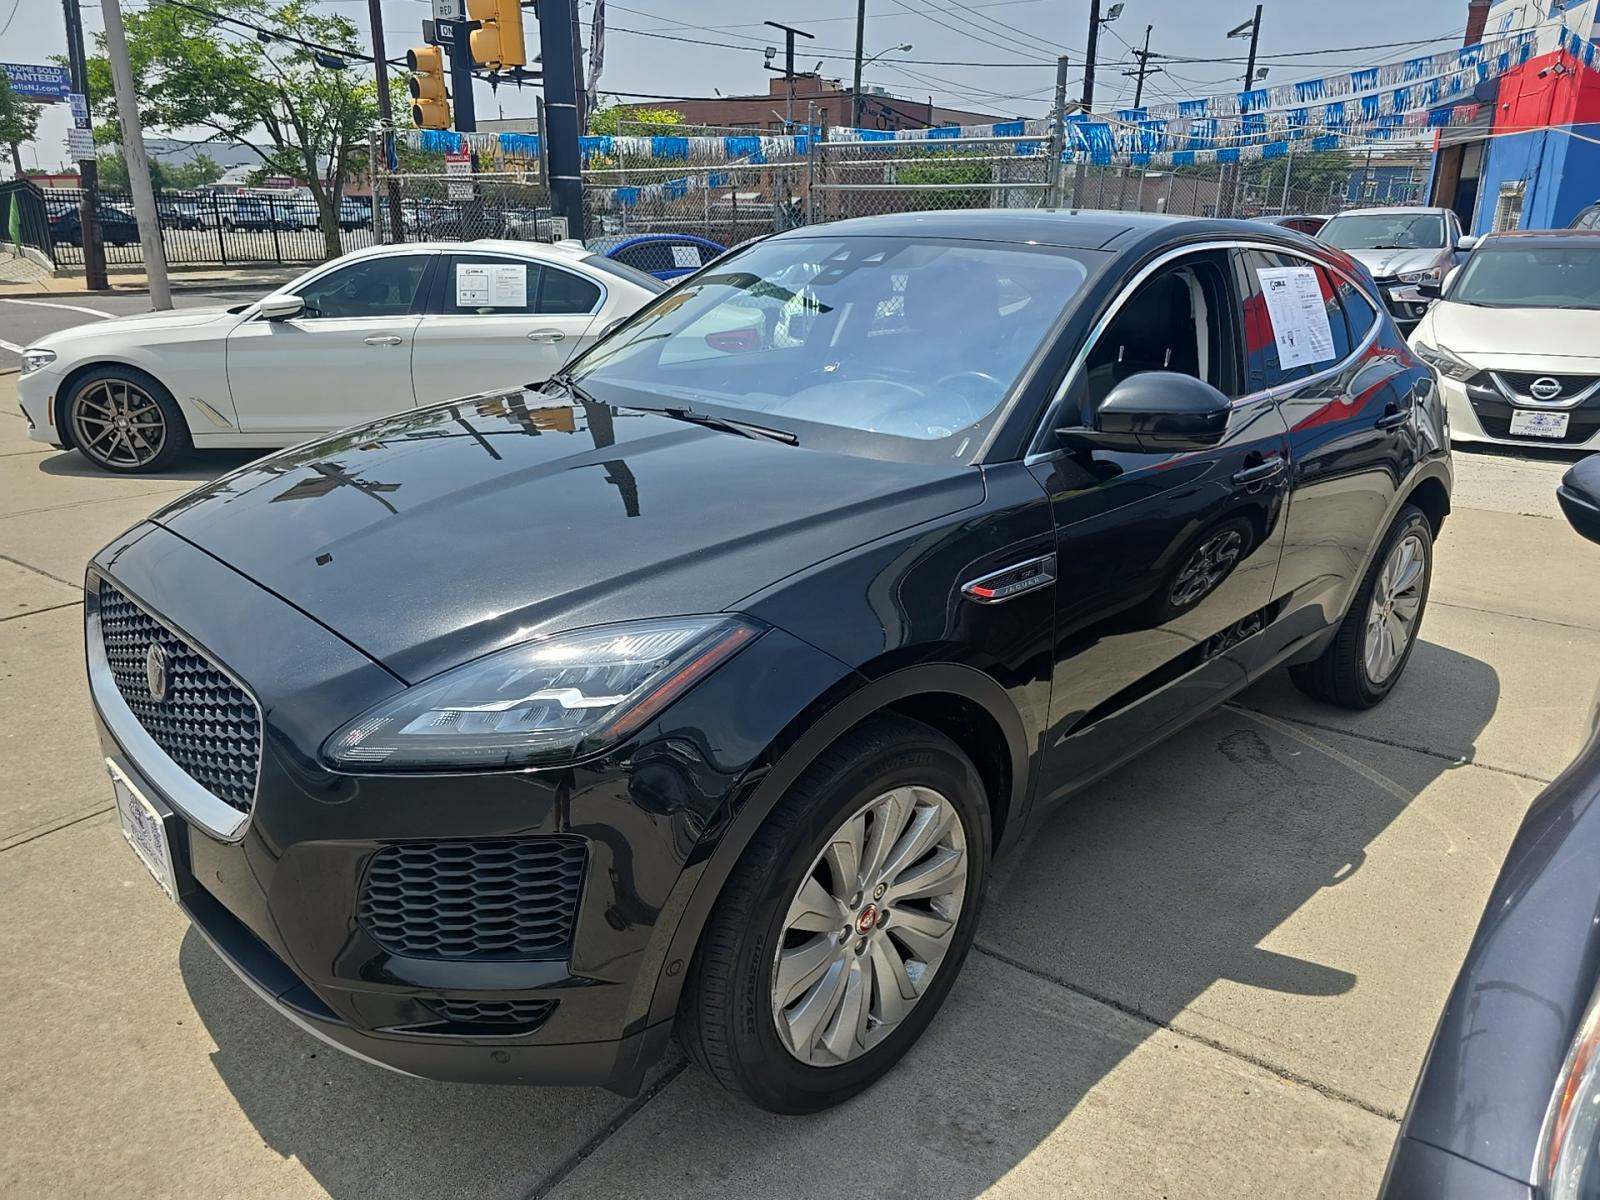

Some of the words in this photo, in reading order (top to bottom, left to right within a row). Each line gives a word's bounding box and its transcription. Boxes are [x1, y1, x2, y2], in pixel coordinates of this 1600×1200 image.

[439, 5, 452, 16] RED
[8, 65, 35, 73] HOME
[37, 67, 61, 75] SOLD
